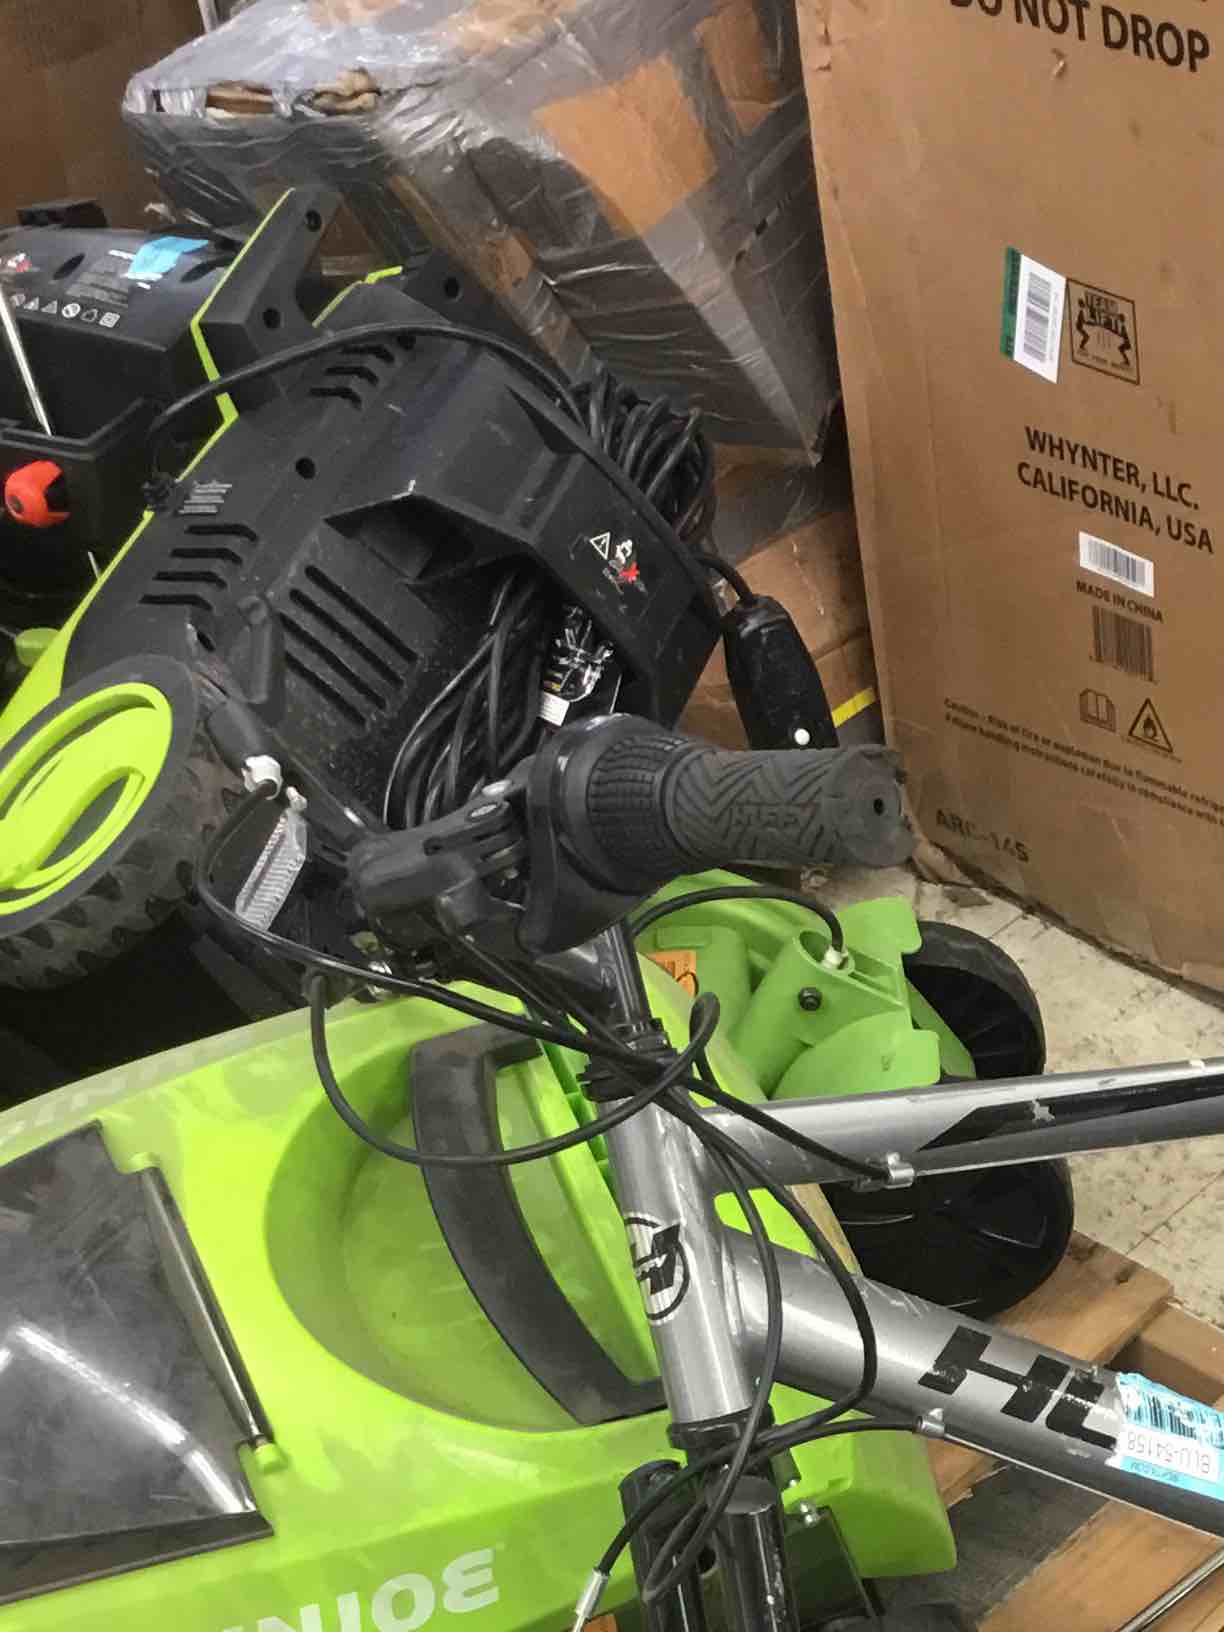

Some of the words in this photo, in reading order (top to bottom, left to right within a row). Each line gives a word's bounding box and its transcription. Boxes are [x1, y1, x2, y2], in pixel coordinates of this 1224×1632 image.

[1014, 0, 1090, 40] NOT
[1101, 6, 1210, 72] DROP
[1025, 426, 1147, 493] WHYNTER,
[1153, 472, 1199, 510] LLC.
[1017, 462, 1160, 536] CALIFORNIA,
[1166, 515, 1214, 554] USA
[1076, 580, 1110, 602] MADE
[1113, 595, 1125, 608] IN
[1126, 600, 1164, 623] CHINA
